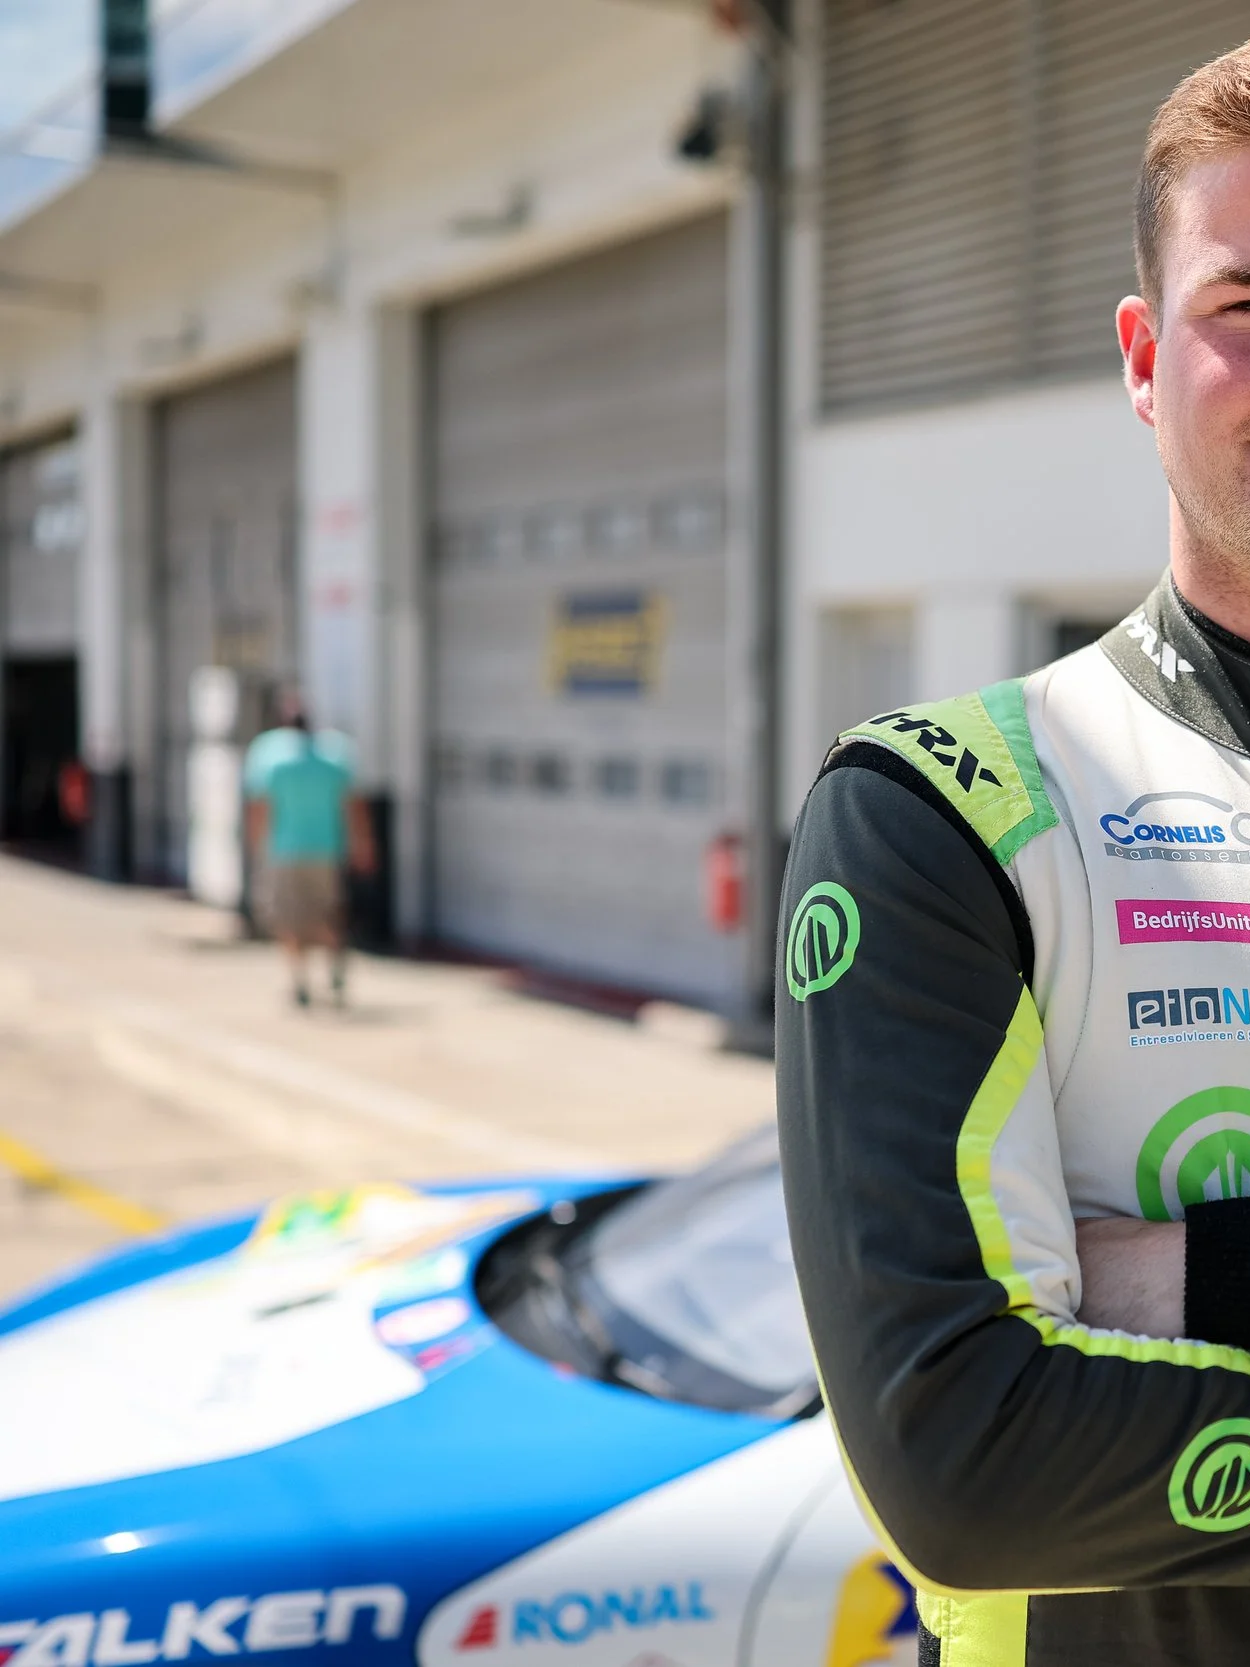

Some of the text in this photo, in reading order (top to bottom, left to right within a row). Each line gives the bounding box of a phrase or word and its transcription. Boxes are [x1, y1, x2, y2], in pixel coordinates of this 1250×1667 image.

[1131, 1031, 1233, 1047] Entresolvloeren
[1237, 1031, 1246, 1041] &
[513, 1581, 716, 1646] RONAL
